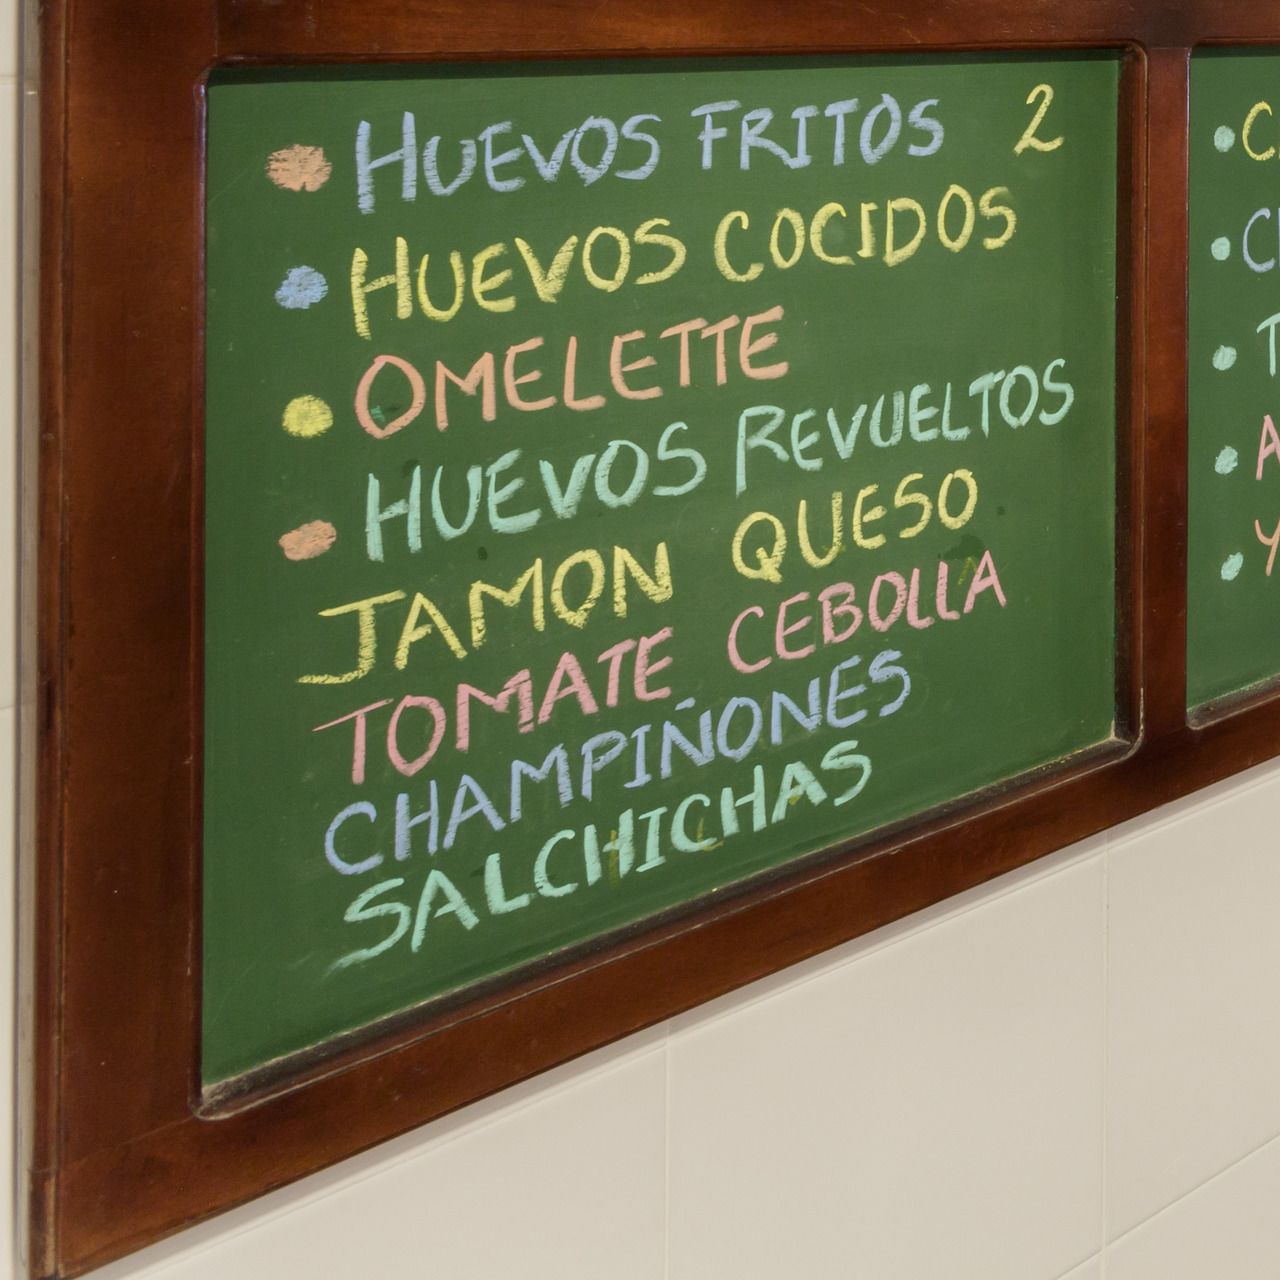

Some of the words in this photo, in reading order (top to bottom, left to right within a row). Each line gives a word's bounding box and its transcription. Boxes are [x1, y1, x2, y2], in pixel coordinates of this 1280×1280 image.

[355, 112, 662, 214] HUEVOS
[690, 93, 946, 170] FRITOS
[1013, 83, 1064, 158] 2
[349, 217, 687, 339] HUEVOS
[713, 184, 1016, 282] COCIDOS
[353, 305, 790, 439] OMELETTE
[364, 421, 708, 562] HUEVOS
[734, 358, 1074, 497] REVUELTOS
[297, 540, 671, 685] JAMON
[731, 468, 978, 583] QUESO
[312, 626, 674, 785] TOMATE
[727, 549, 1008, 675] CEBOLLA
[323, 648, 911, 875] CHAMPIÑONES
[326, 739, 873, 971] SALCHICHAS
